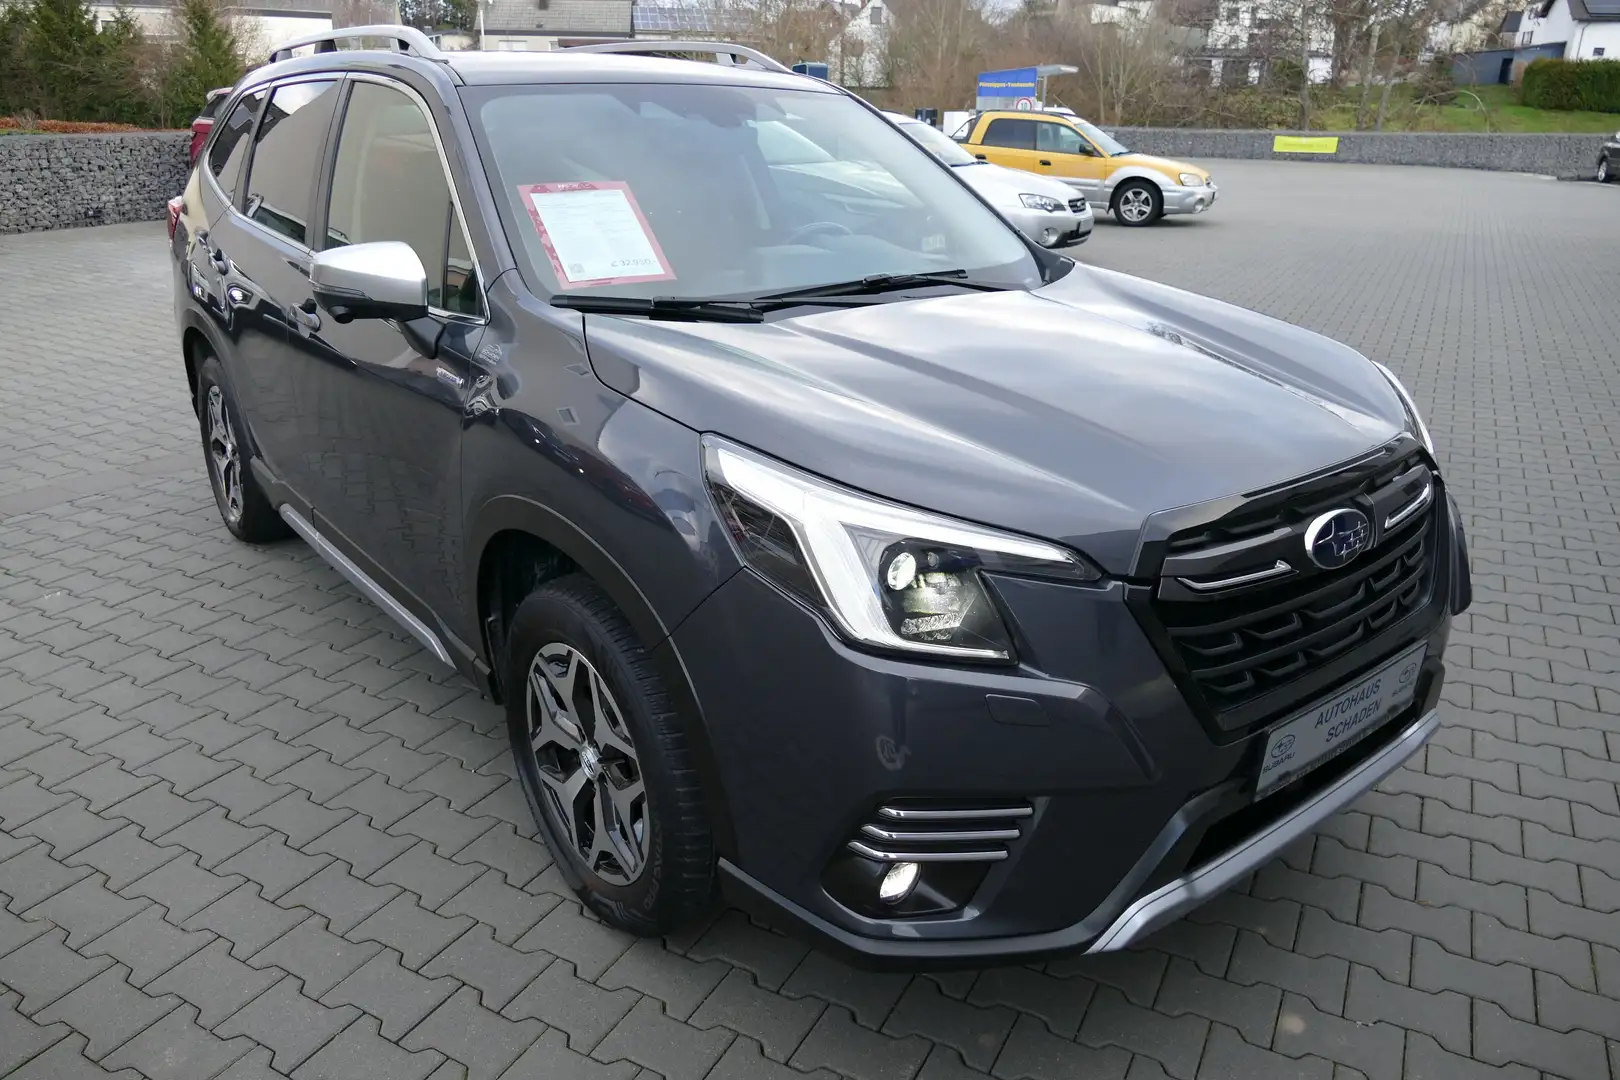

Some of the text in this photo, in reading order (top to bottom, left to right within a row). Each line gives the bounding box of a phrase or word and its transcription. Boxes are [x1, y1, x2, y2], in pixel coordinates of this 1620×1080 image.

[1314, 679, 1382, 728] AUTOHAUS
[1325, 699, 1382, 742] SCHADEN
[1262, 751, 1296, 774] SUBARU
